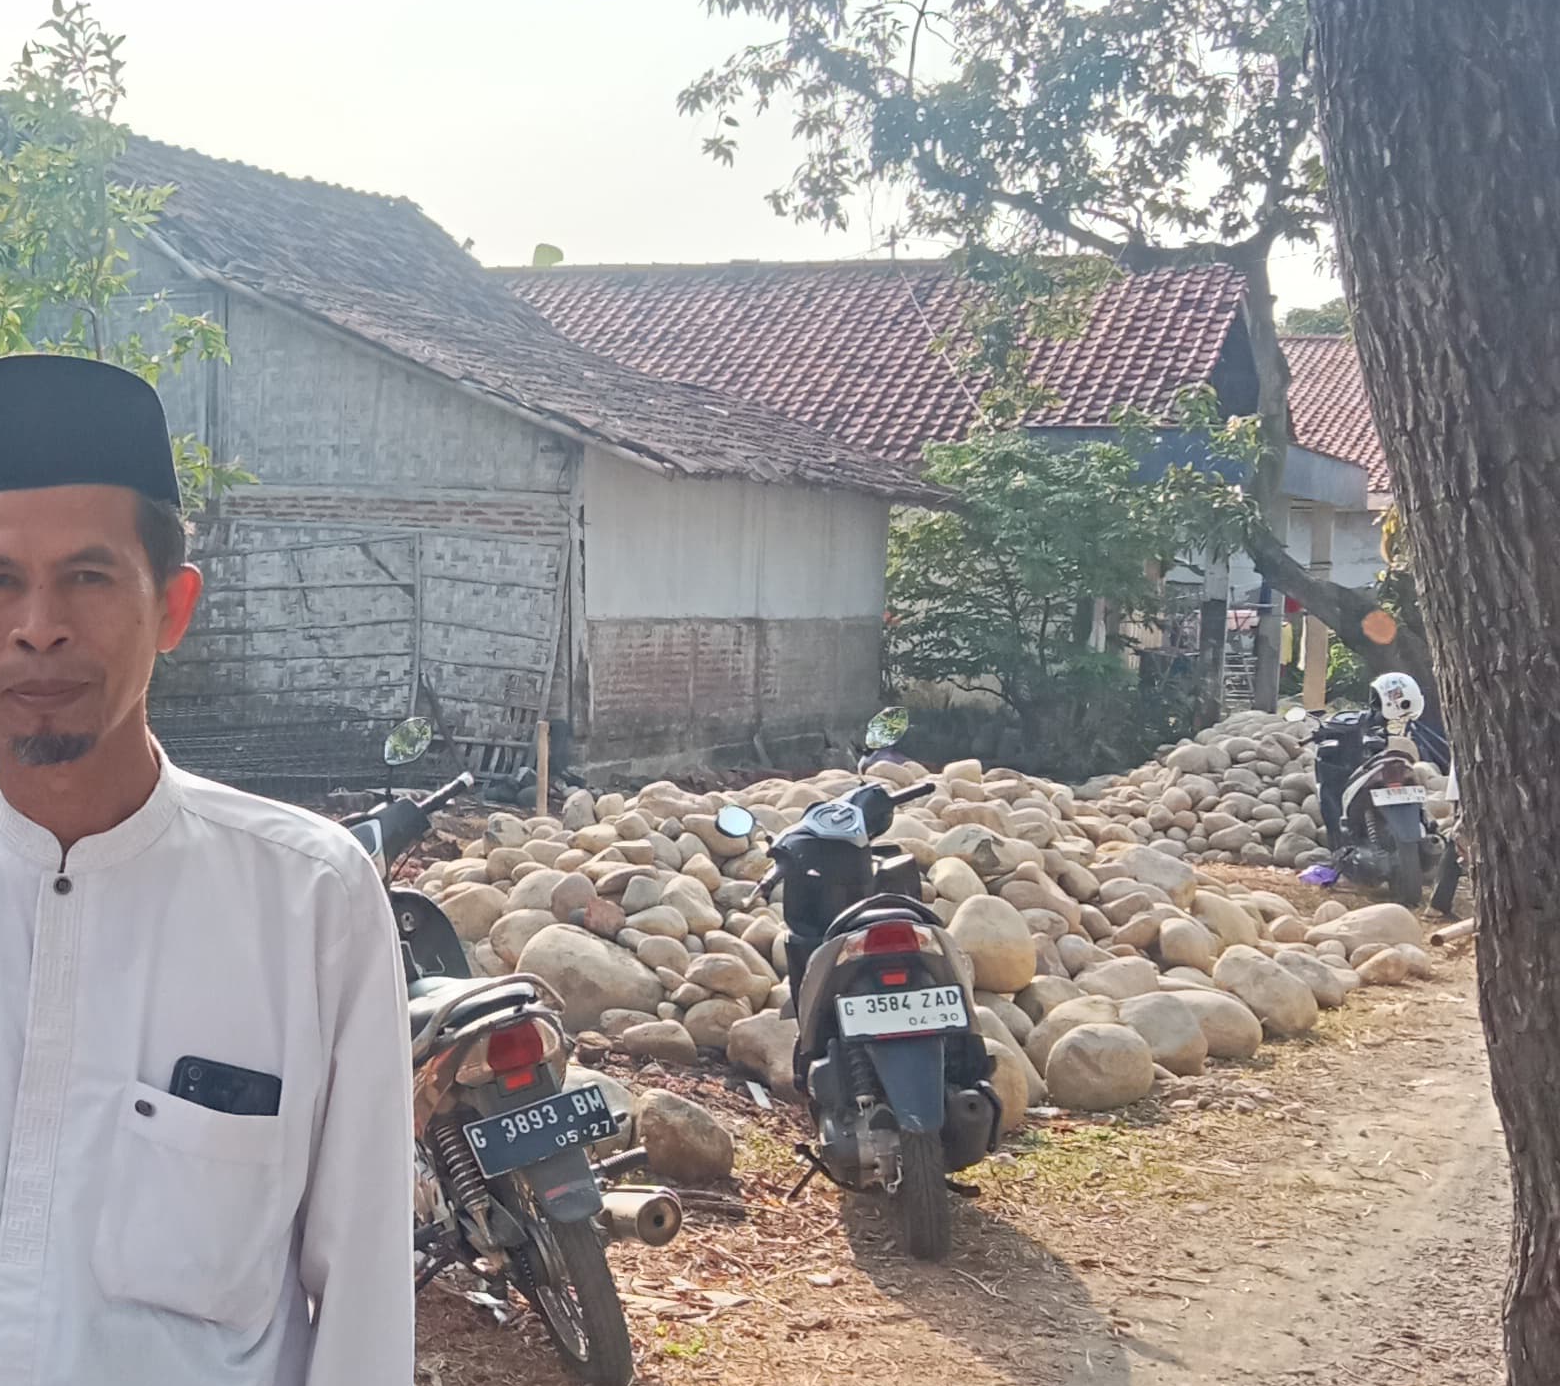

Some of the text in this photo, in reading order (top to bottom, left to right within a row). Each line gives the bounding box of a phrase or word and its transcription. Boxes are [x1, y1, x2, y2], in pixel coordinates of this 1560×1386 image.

[865, 994, 912, 1014] 3584
[921, 990, 960, 1008] ZAD
[501, 1104, 558, 1140] 3893
[571, 1088, 606, 1116] BM
